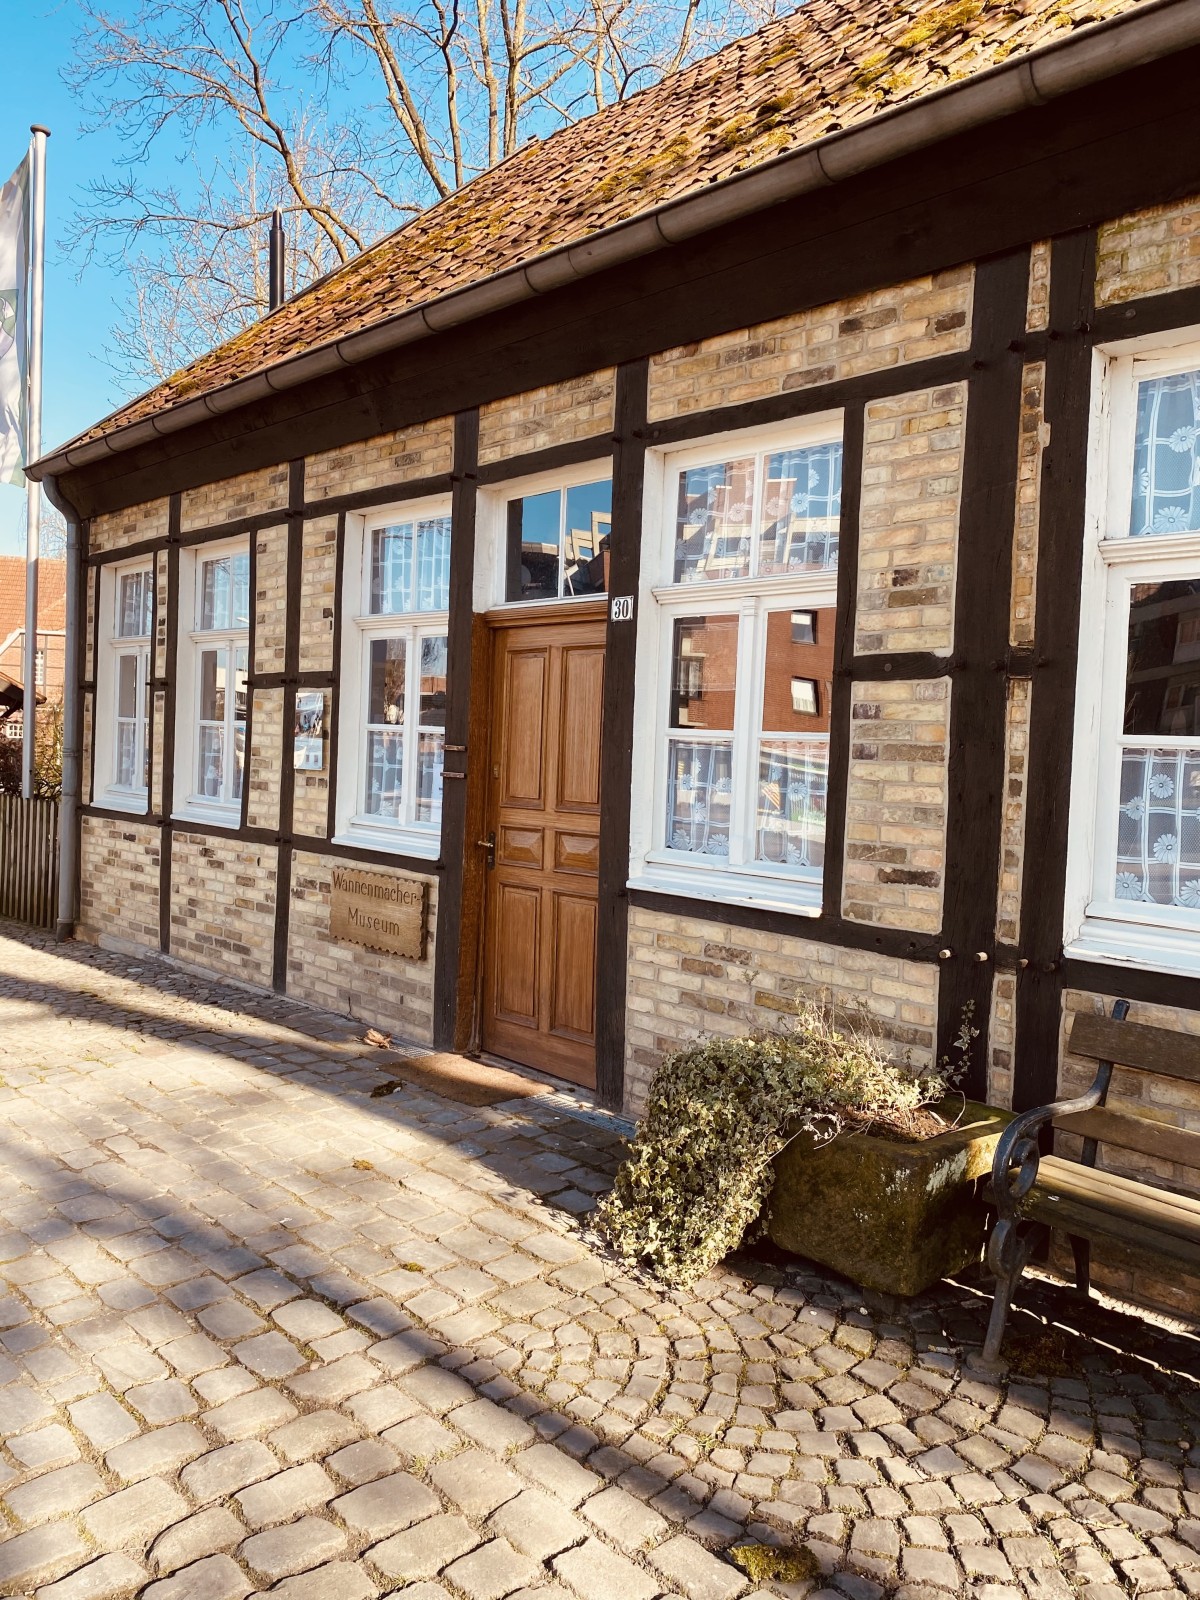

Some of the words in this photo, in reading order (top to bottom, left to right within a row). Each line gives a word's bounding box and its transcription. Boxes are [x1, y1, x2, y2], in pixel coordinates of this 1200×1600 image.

[614, 599, 629, 619] 30
[332, 870, 420, 905] Wannenmacher-
[347, 906, 400, 936] Museum
